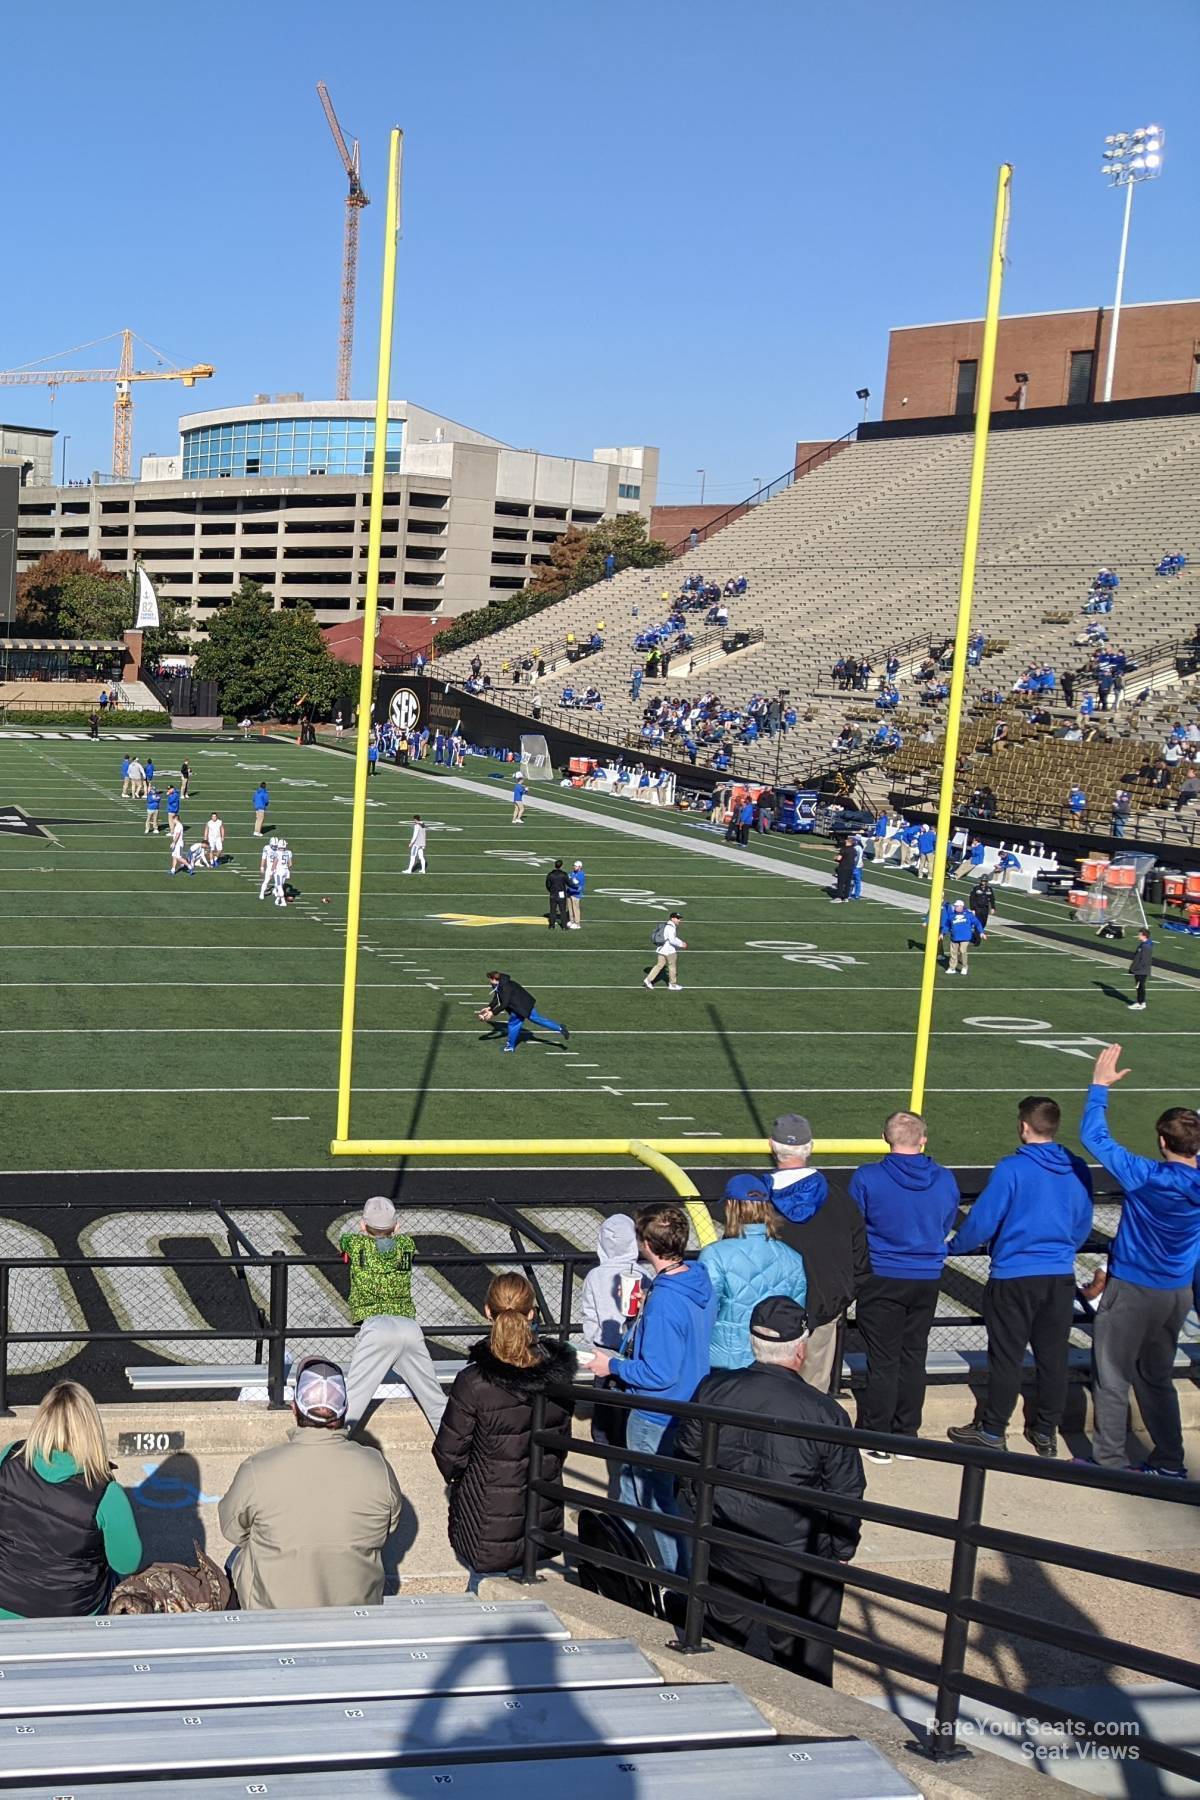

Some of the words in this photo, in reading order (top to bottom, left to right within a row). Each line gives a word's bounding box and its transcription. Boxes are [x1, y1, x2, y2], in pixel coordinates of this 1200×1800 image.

[392, 691, 418, 730] SEC
[593, 888, 687, 906] 30
[745, 941, 870, 965] 20
[133, 1433, 170, 1450] 130
[563, 1645, 579, 1653] 26
[279, 1657, 295, 1665] 24
[661, 1692, 679, 1701] 26
[505, 1701, 521, 1709] 25
[346, 1709, 362, 1717] 24
[184, 1717, 200, 1725] 23
[790, 1753, 811, 1762] 26
[434, 1775, 452, 1784] 24
[248, 1784, 266, 1793] 23
